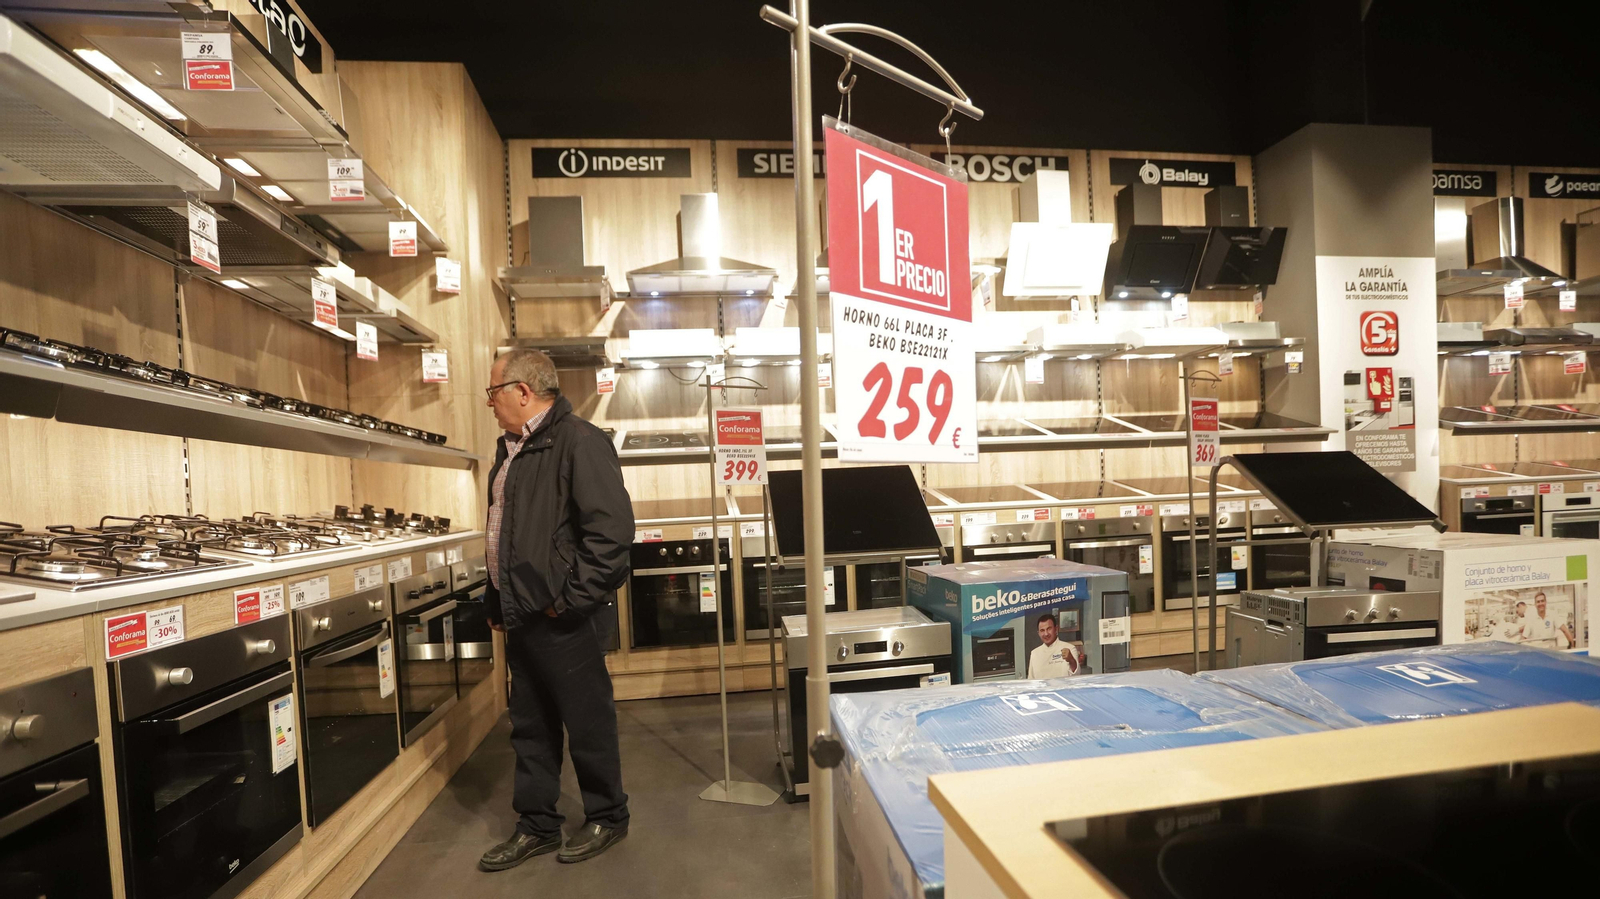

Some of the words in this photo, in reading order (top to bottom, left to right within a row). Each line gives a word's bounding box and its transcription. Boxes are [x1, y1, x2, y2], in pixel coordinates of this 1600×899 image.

[199, 44, 213, 54] 89
[337, 167, 350, 175] 109
[1162, 168, 1208, 185] Balay
[863, 169, 895, 285] 1
[895, 228, 914, 260] ER
[897, 258, 945, 297] PRECIO
[1358, 265, 1394, 278] AMPLÍA
[1345, 282, 1356, 292] LA
[1360, 279, 1408, 292] GARANTÍA
[844, 306, 880, 328] HORNO
[884, 317, 900, 331] 66L
[905, 320, 933, 338] PLACA
[938, 328, 948, 341] 3F
[1371, 320, 1387, 344] 5
[869, 333, 896, 351] BEKO
[900, 339, 948, 360] BSE22121X
[858, 362, 953, 445] 259
[719, 424, 760, 433] Conforama
[1195, 444, 1215, 462] 369
[724, 460, 758, 480] 399
[1374, 559, 1390, 567] Balay
[1465, 567, 1495, 578] Conjunto
[1465, 577, 1483, 587] placa
[1485, 574, 1530, 584] vitrocerámica
[1531, 572, 1550, 580] Balay
[945, 588, 958, 603] beko
[972, 589, 1020, 614] beko
[238, 604, 259, 613] Conforama
[266, 601, 280, 610] -25%
[972, 612, 999, 622] Soluções
[999, 603, 1033, 616] inteligentes
[110, 629, 145, 643] Conforama
[155, 626, 178, 639] -30%
